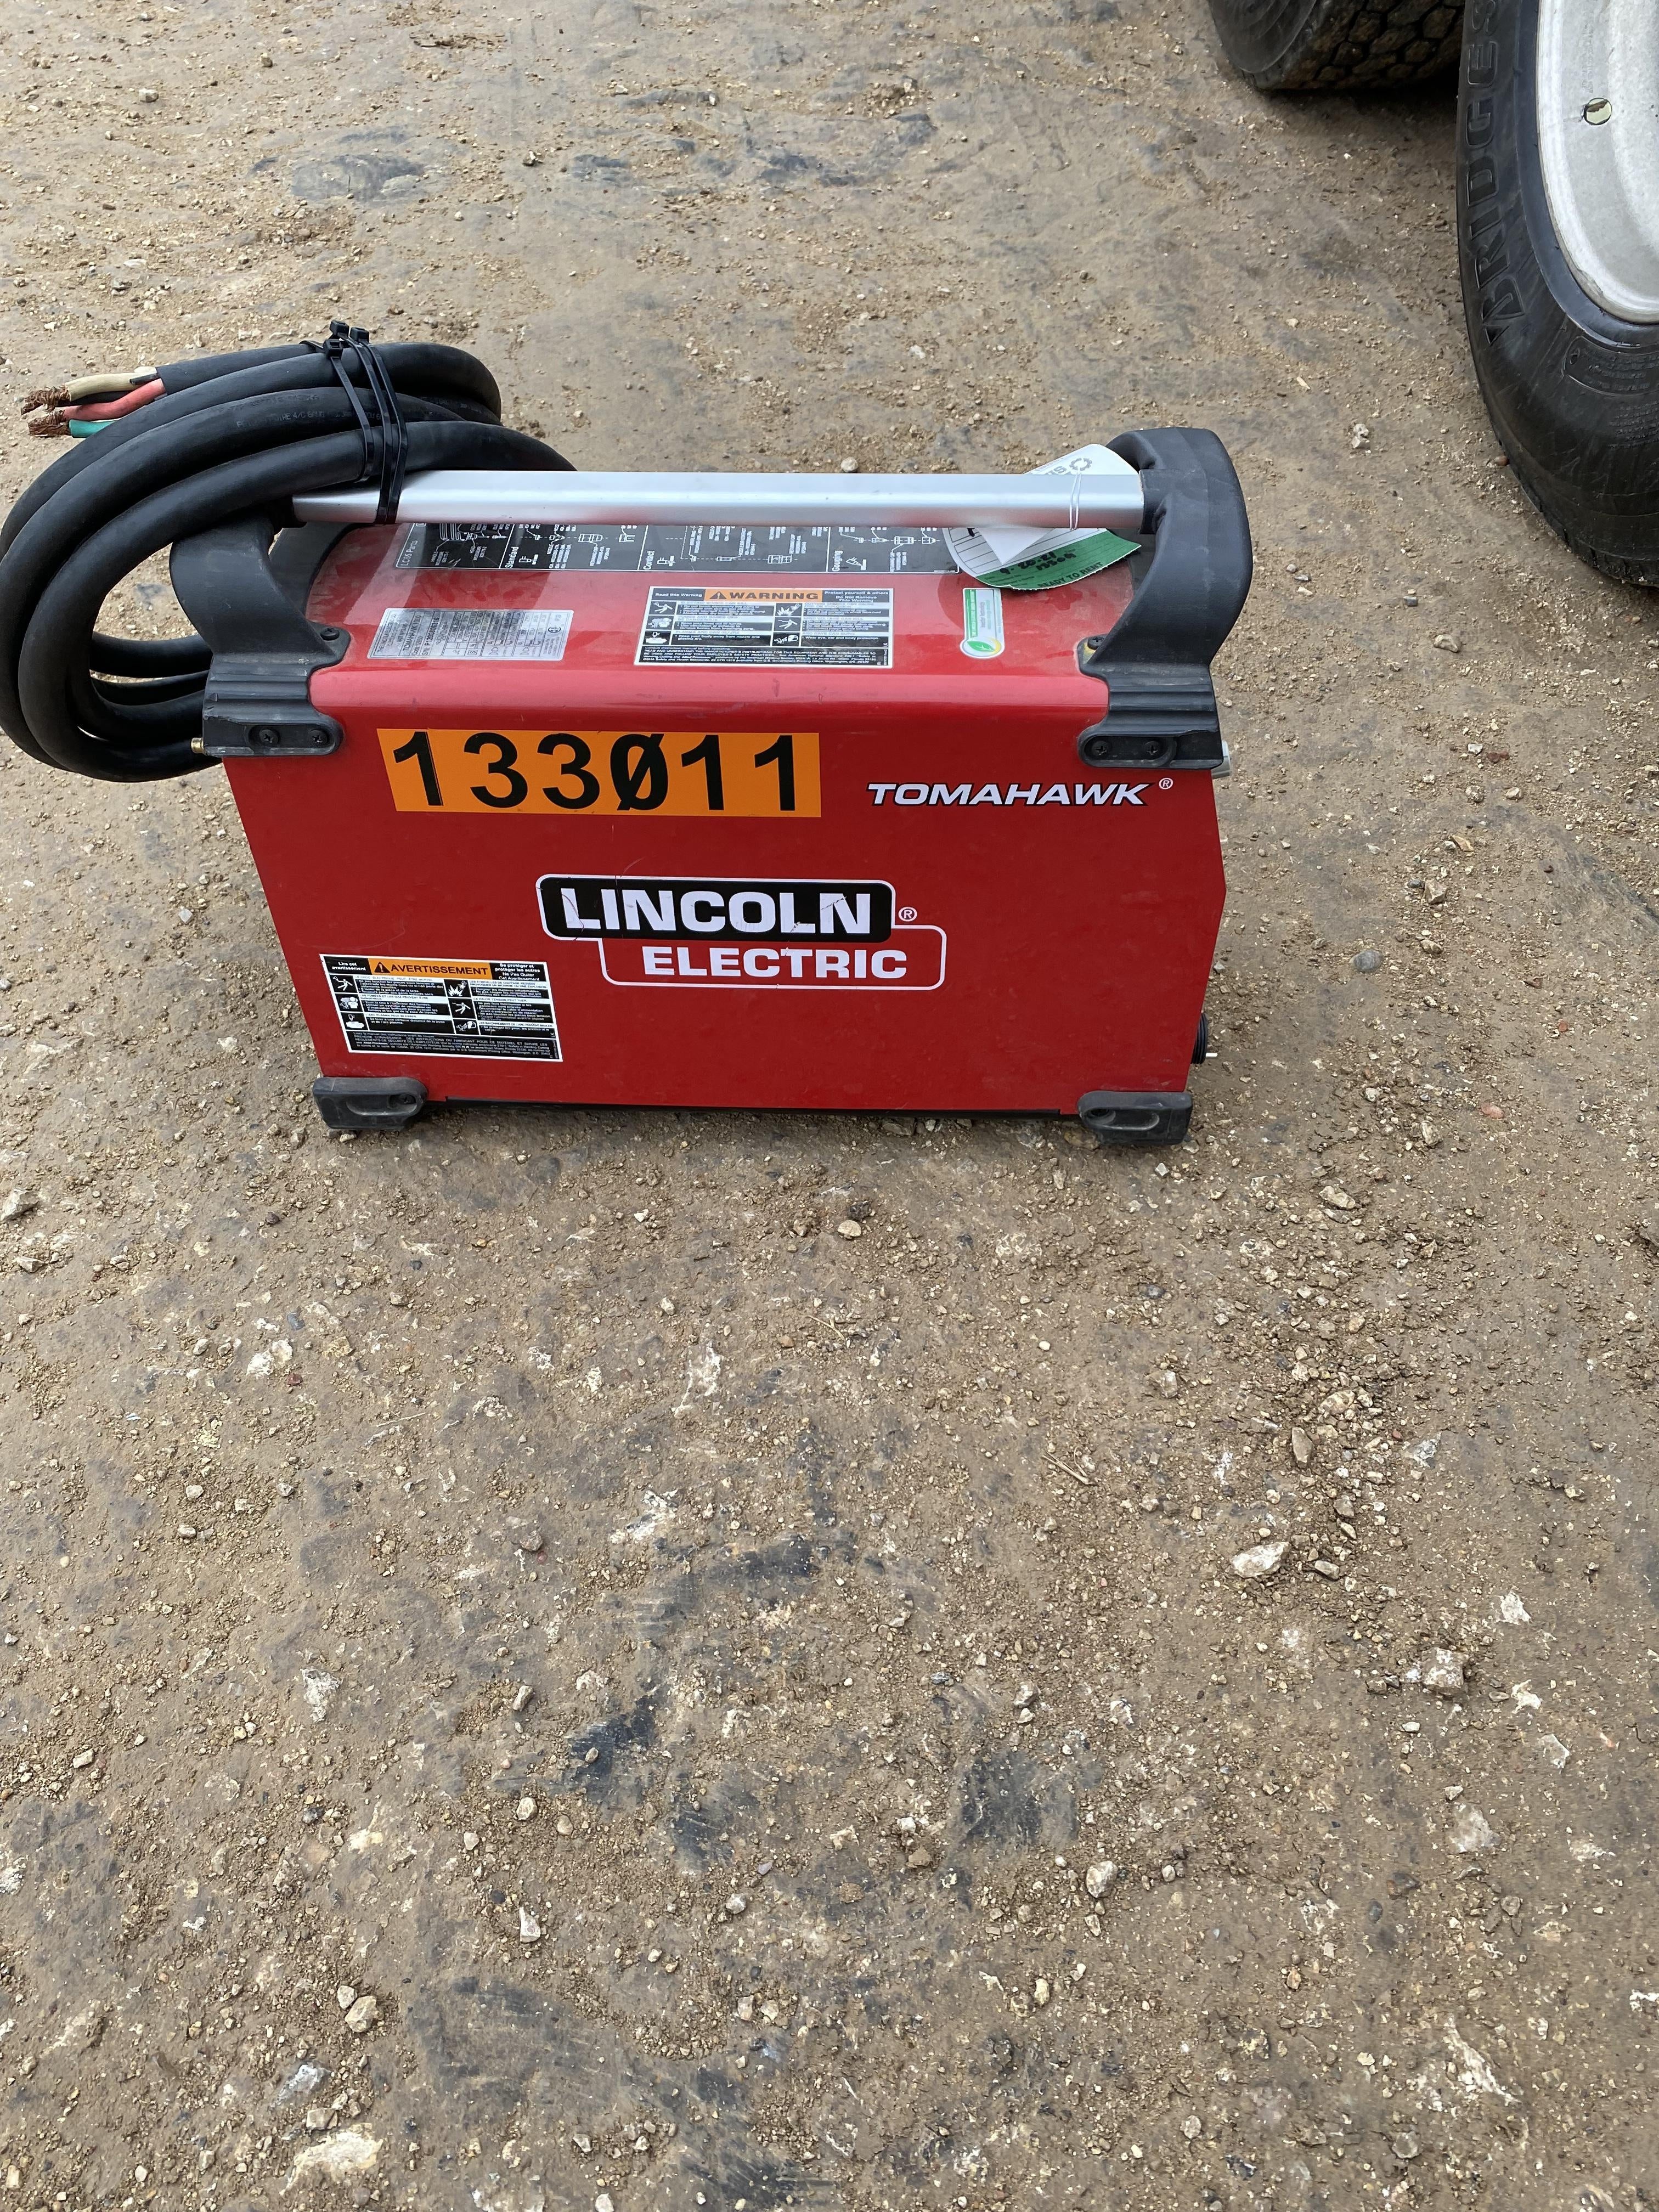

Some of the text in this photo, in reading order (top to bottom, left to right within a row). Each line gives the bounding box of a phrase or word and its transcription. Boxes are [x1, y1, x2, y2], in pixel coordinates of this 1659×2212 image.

[505, 546, 519, 568] Standard
[643, 550, 655, 569] Contact
[831, 550, 843, 572] Gouging
[1081, 561, 1104, 575] RENT
[403, 624, 417, 651] TOMAHAWK
[868, 783, 1150, 805] TOMAHAWK
[561, 888, 871, 934] LINCOLN
[391, 964, 488, 975] AVERTISSEMENT
[643, 946, 907, 979] ELECTRIC
